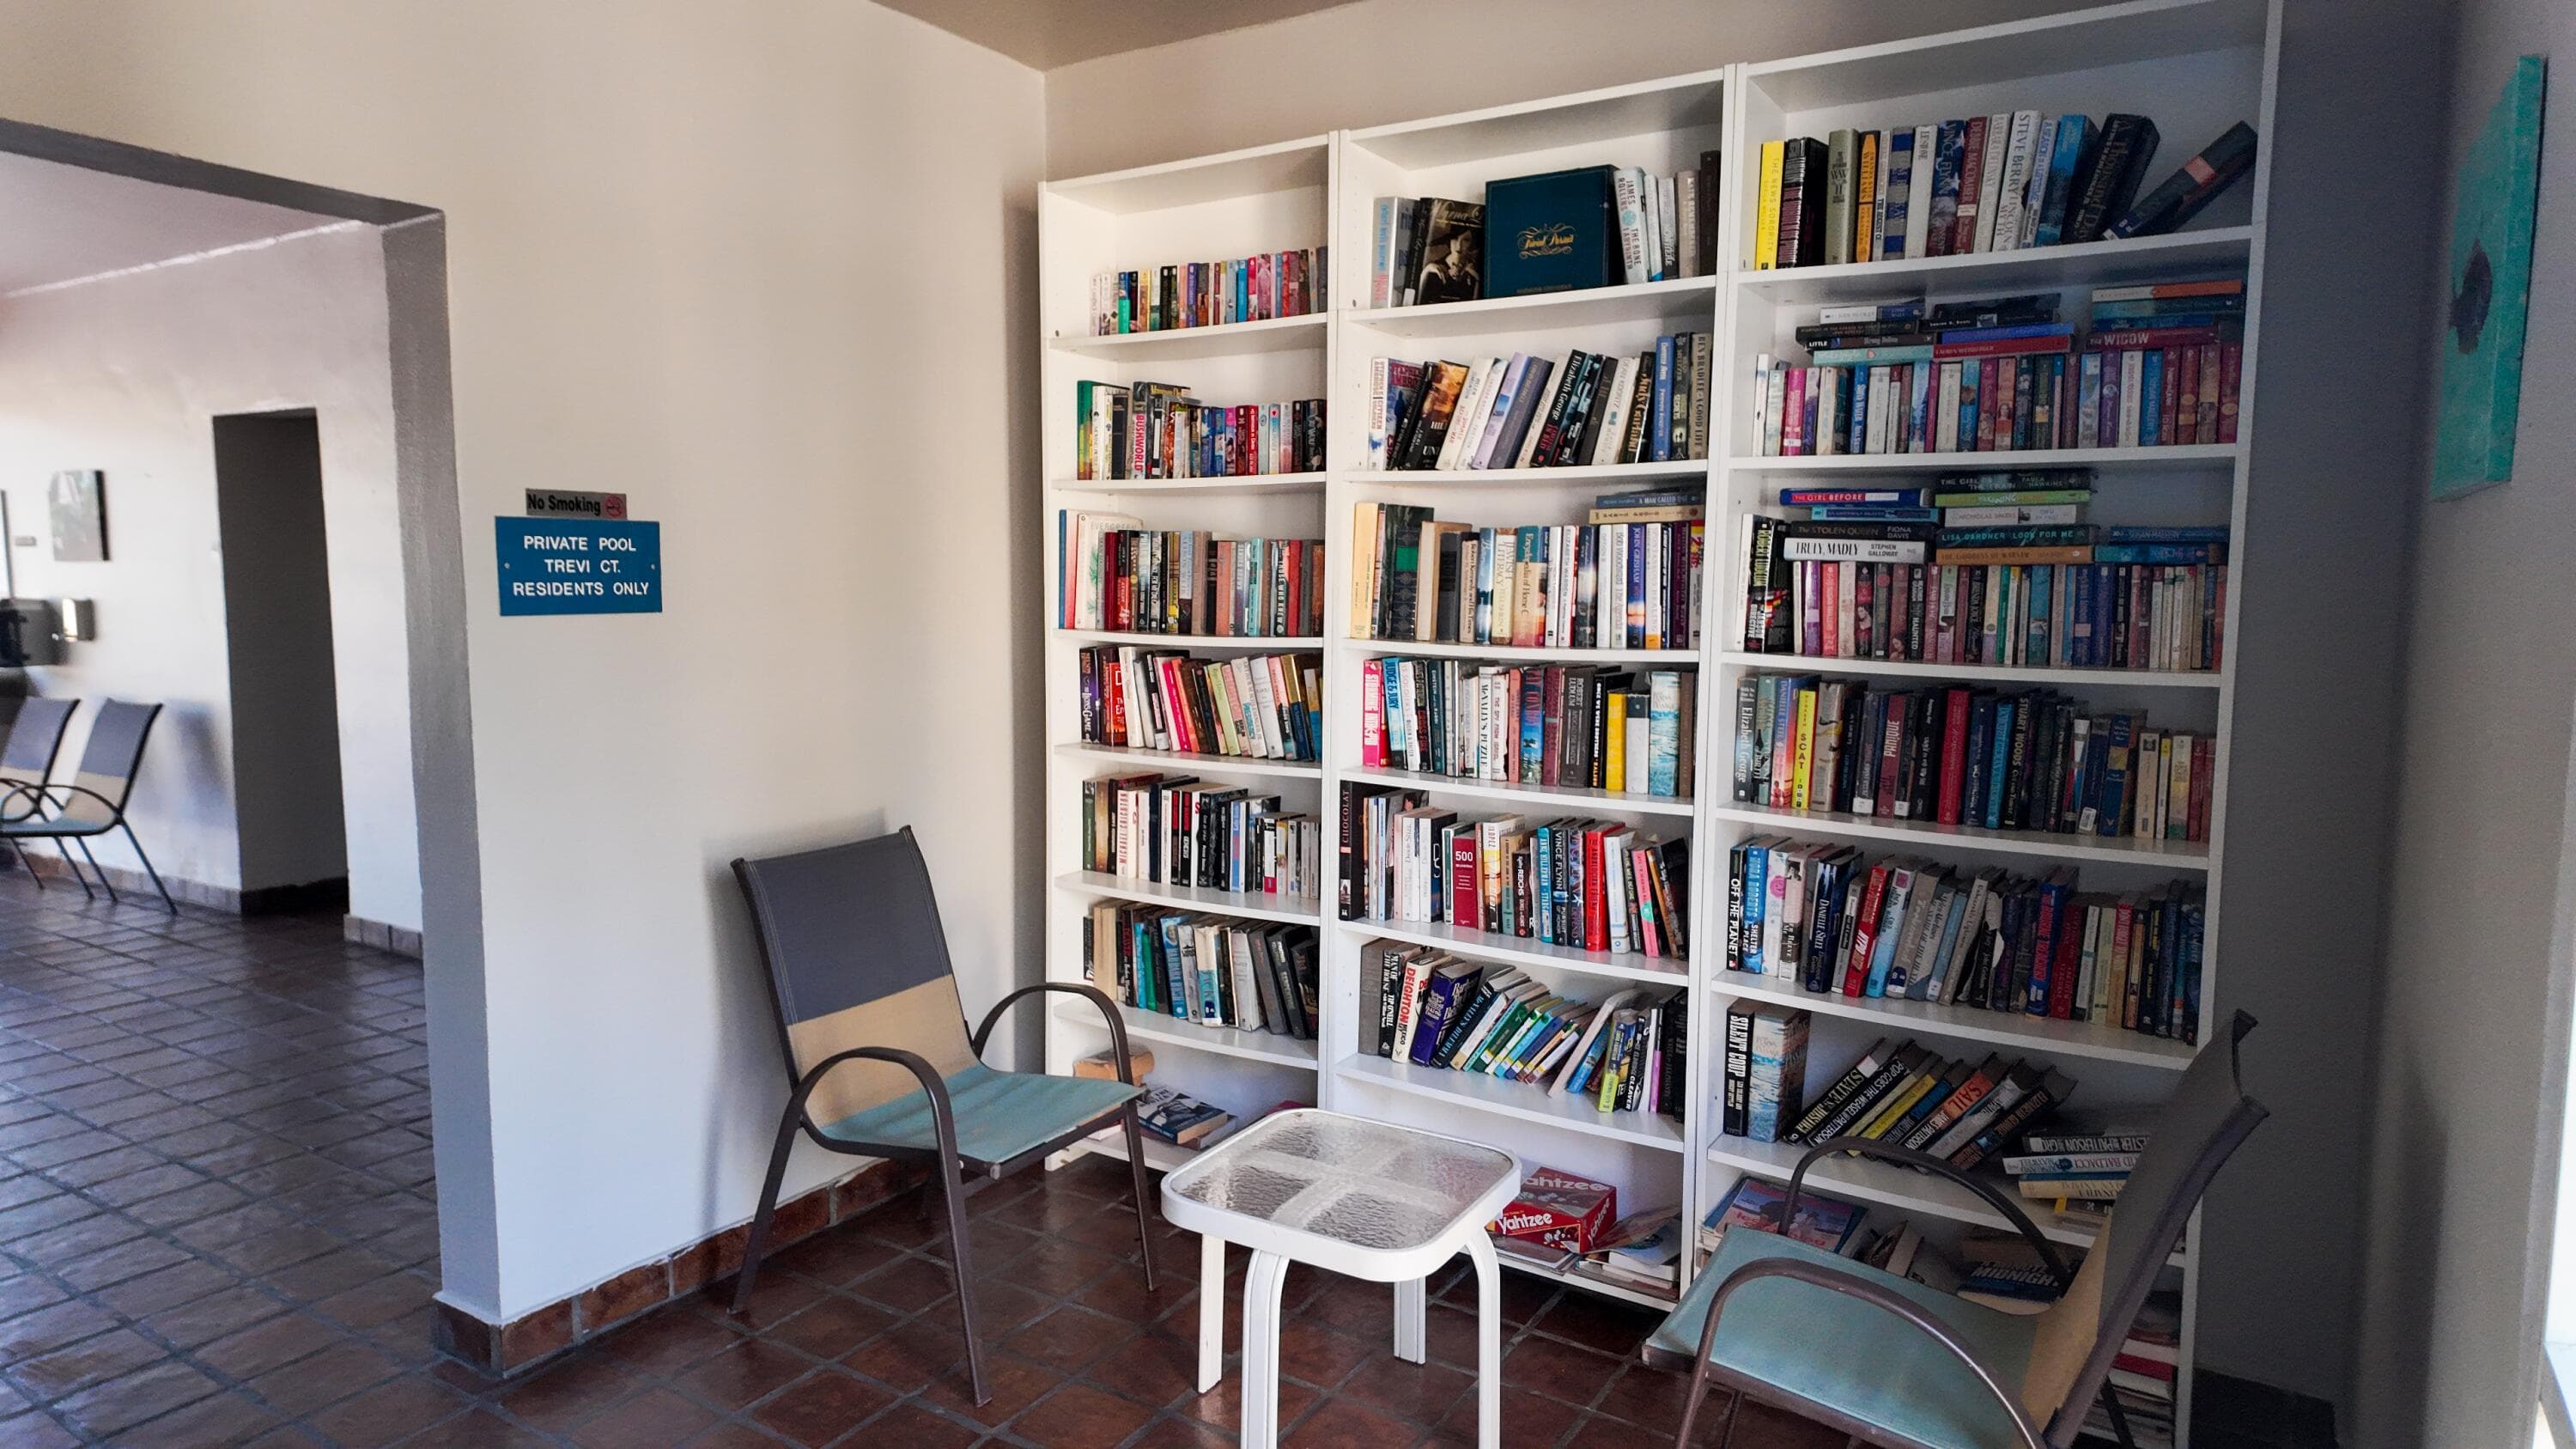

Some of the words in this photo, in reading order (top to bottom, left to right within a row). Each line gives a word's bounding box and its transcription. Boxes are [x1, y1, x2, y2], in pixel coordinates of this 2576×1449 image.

[1941, 123, 1957, 158] VINCE
[2014, 114, 2031, 152] STEVE
[1937, 161, 1952, 194] FLYNN
[2008, 155, 2025, 196] BERRY
[1618, 178, 1628, 211] ROLLINS
[1626, 180, 1636, 204] JAMES
[1622, 228, 1633, 270] LABYRINTH
[1697, 337, 1705, 354] BEN
[2105, 332, 2149, 344] WIDOW
[1563, 355, 1583, 392] Elizabeth
[1552, 393, 1568, 421] George
[1134, 413, 1145, 472] BUSHWORLD
[527, 494, 544, 510] No
[549, 496, 601, 516] Smoking
[1632, 527, 1641, 548] JOHN
[1812, 526, 1844, 534] STOLEN
[524, 536, 587, 550] PRIVATE
[599, 539, 636, 551] POOL
[1522, 533, 1534, 578] Encyclopedia
[1754, 530, 1771, 556] ROBERT
[1796, 542, 1826, 555] TRULY,
[1828, 542, 1860, 555] MADLY
[544, 559, 590, 573] TREVI
[600, 561, 620, 572] CT.
[1497, 543, 1506, 585] LITERACY
[1505, 542, 1515, 580] JEWISH
[513, 582, 604, 596] RESIDENTS
[613, 582, 649, 594] ONLY
[1467, 564, 1476, 592] Kennedy
[1747, 604, 1759, 638] DIRECTIVE
[1386, 661, 1397, 684] JUDGE
[1389, 693, 1399, 709] JURY
[1596, 700, 1601, 709] WE
[1778, 680, 1788, 715] DANIELLE
[1083, 710, 1092, 731] GAME
[2016, 698, 2029, 731] STUART
[1741, 707, 1753, 749] Elizabeth
[1777, 718, 1786, 740] STEEL
[2012, 734, 2026, 766] WOODS
[1737, 752, 1749, 782] George
[1120, 794, 1128, 828] CRICHTON
[1455, 850, 1473, 862] 500
[1730, 879, 1740, 896] OFF
[1747, 881, 1759, 918] ROBERTS
[1729, 900, 1740, 917] THE
[1817, 899, 1829, 928] DANIELLE
[1728, 920, 1739, 956] PLANET
[1786, 935, 1795, 957] REEVE
[1814, 930, 1826, 949] STEEL
[1390, 971, 1398, 981] OF
[1400, 968, 1415, 1023] DEIGHTON
[1386, 1005, 1394, 1027] O'NEILL
[1438, 1027, 1464, 1057] DILEMMA
[1729, 1015, 1748, 1051] SILENT
[1728, 1052, 1747, 1077] COUP
[1886, 1060, 1905, 1078] POP
[1625, 1076, 1635, 1110] CLEAVER
[1826, 1068, 1865, 1106] STATE
[1862, 1084, 1879, 1100] THE
[1873, 1071, 1893, 1091] GOES
[1844, 1093, 1869, 1117] WEASEL
[1947, 1080, 1983, 1115] SAIL
[1793, 1101, 1830, 1136] JUSTICE
[1812, 1113, 1847, 1146] PATTERSON
[1929, 1110, 1950, 1130] JAMES
[1903, 1122, 1935, 1153] PATTERSON
[2041, 1138, 2057, 1151] GRO
[2064, 1138, 2112, 1150] PATTERSON
[2075, 1158, 2120, 1169] BALDACCI
[1523, 1176, 1611, 1191] ahtzee
[1497, 1213, 1552, 1235] Yahtzee
[1971, 1266, 2059, 1287] MIDNIGH
